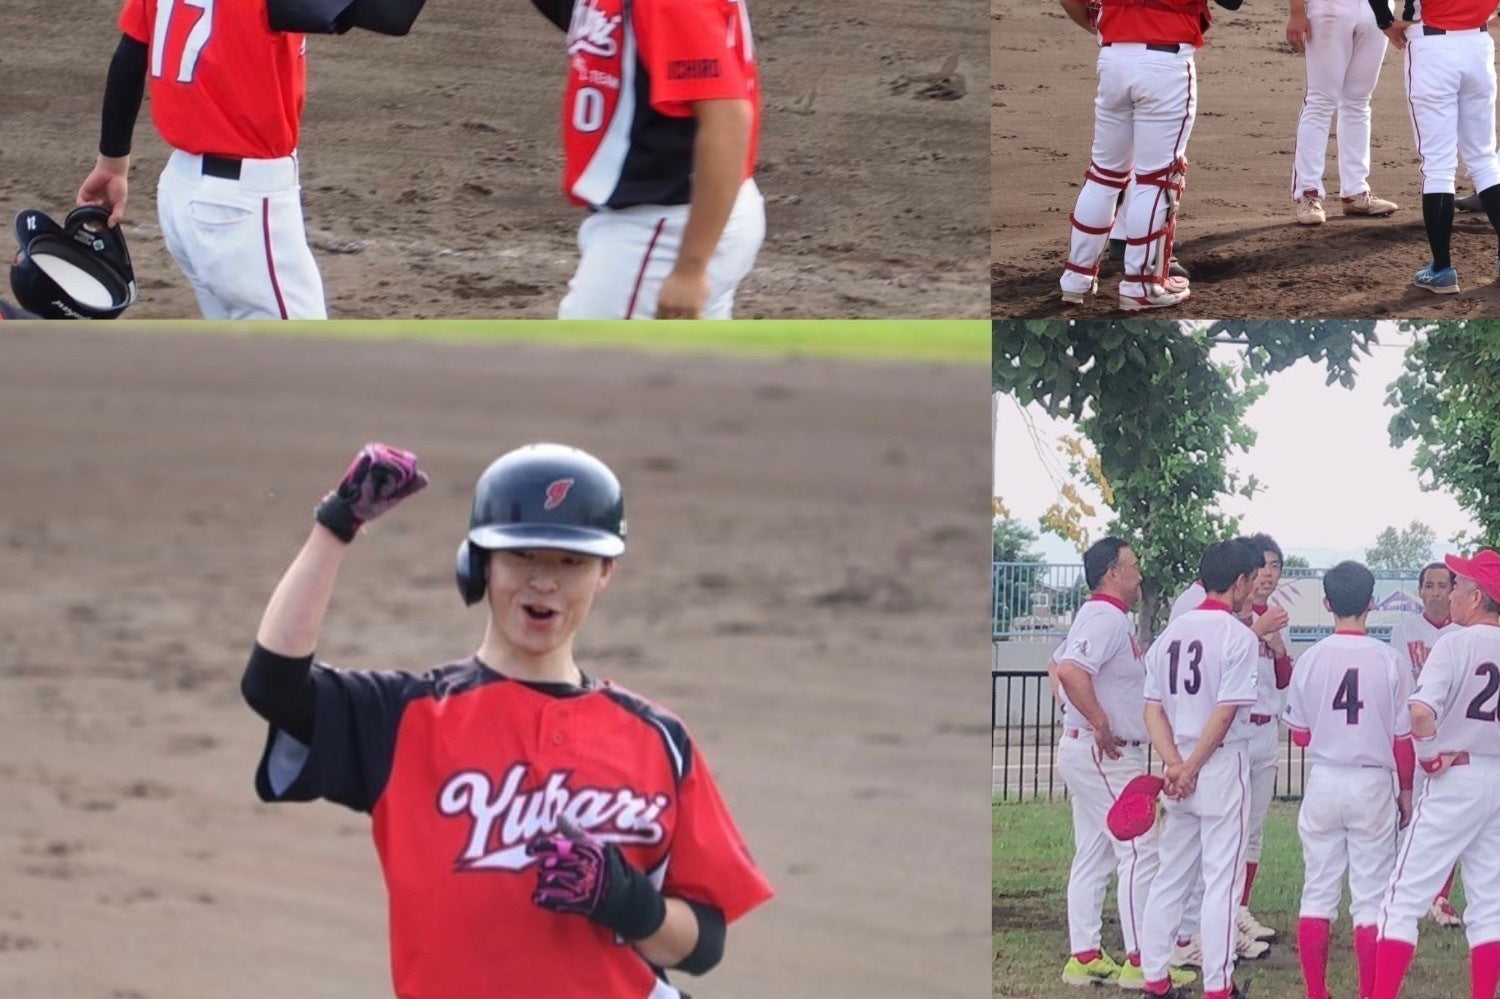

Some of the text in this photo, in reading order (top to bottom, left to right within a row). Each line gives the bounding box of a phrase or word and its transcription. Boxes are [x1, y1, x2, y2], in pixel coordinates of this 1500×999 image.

[1166, 639, 1204, 695] 13
[1332, 668, 1363, 725] 4
[437, 763, 668, 872] Yubari
